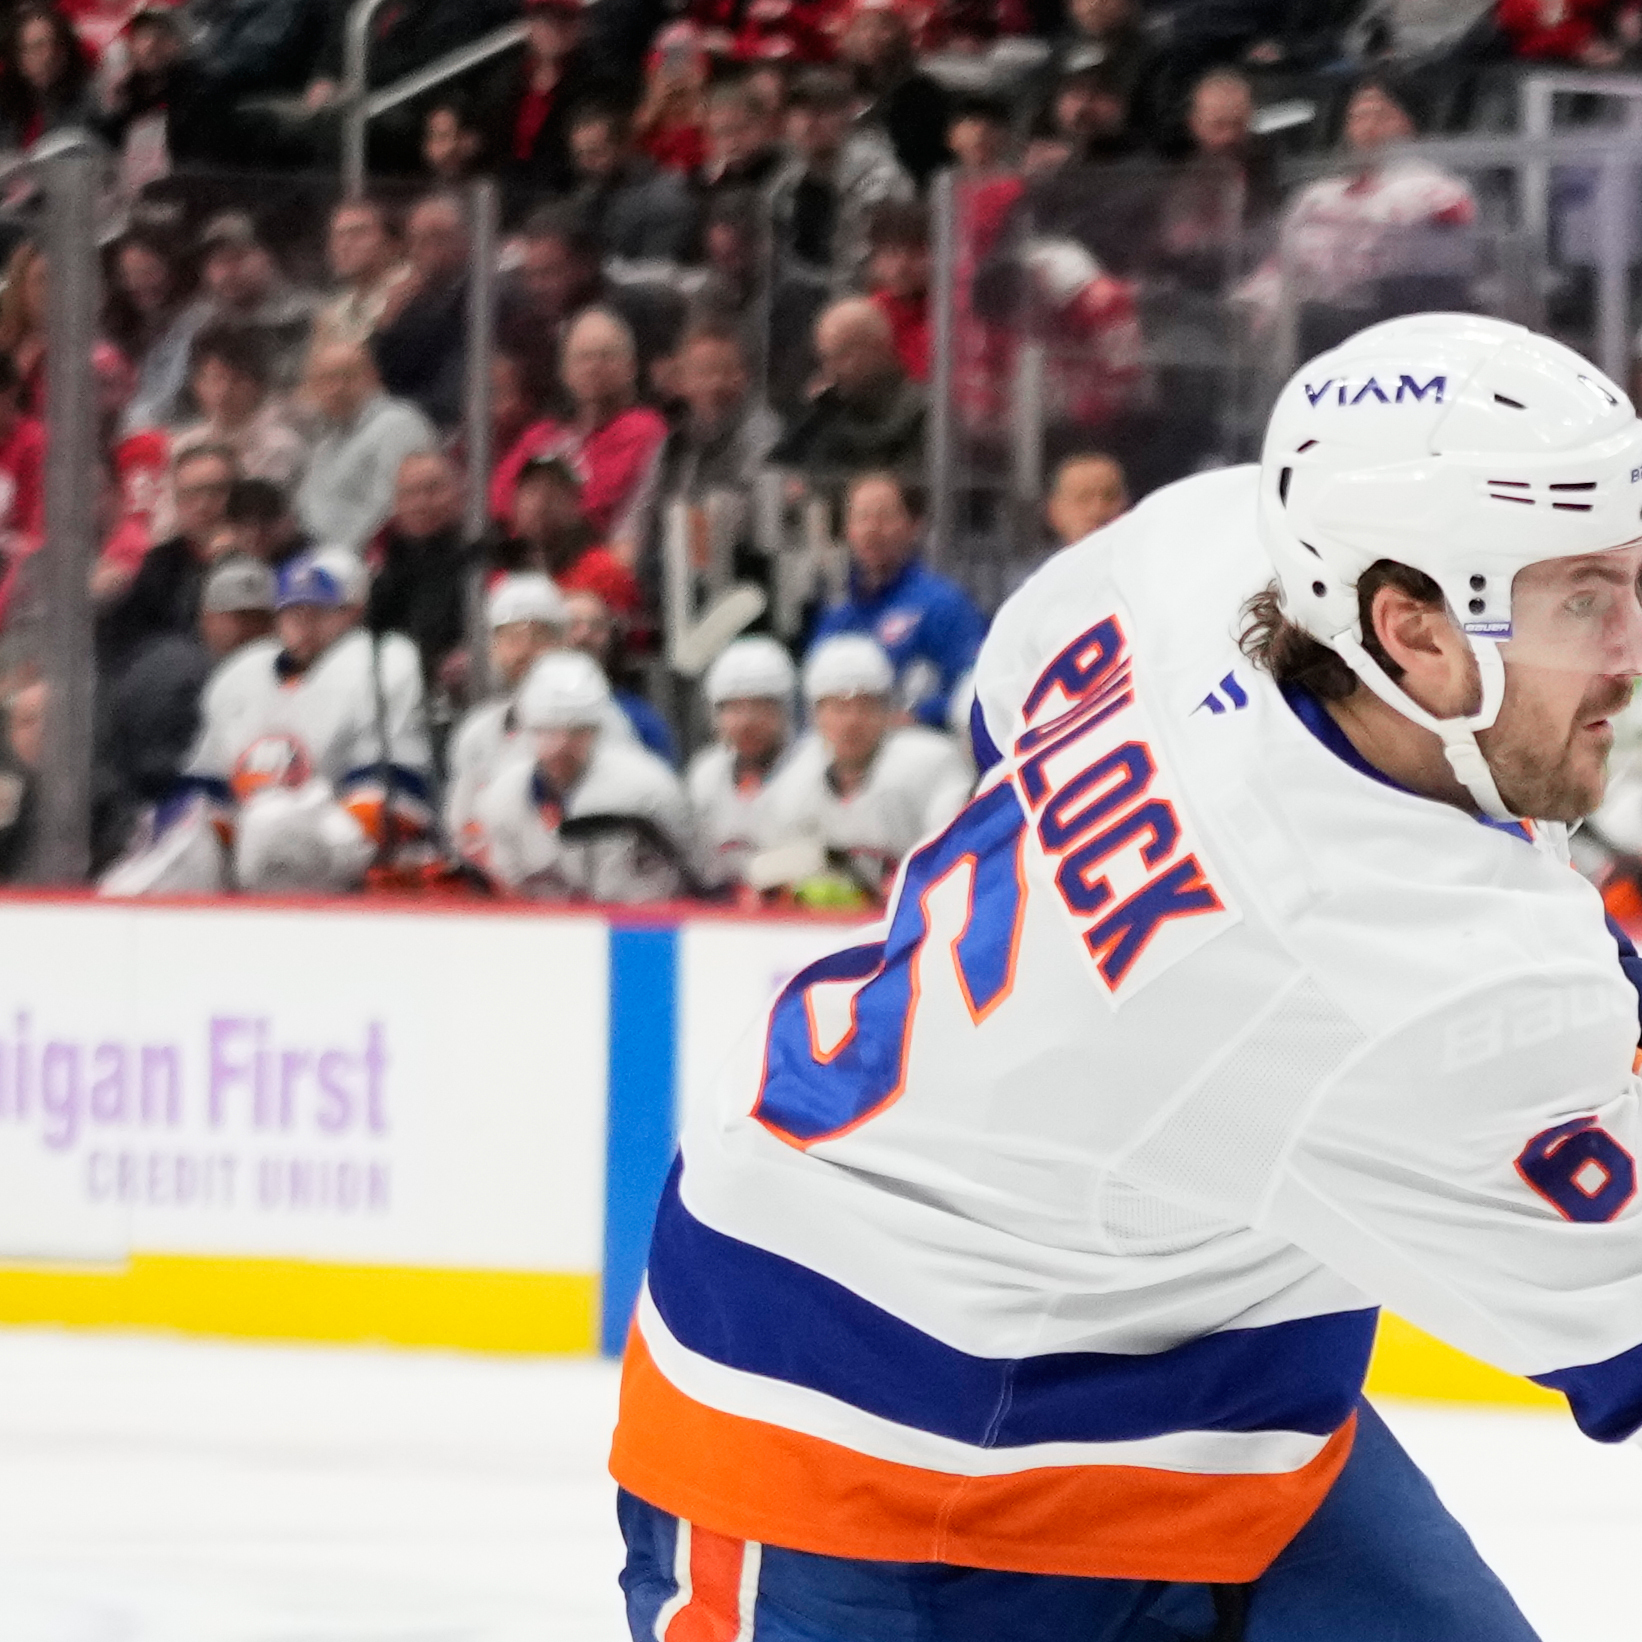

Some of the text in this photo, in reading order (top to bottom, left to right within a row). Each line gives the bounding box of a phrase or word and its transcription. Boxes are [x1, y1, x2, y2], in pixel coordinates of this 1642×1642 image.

[1303, 375, 1448, 408] VIAM
[206, 1013, 393, 1137] First
[86, 1149, 394, 1214] CREDIT UNION
[1513, 1115, 1638, 1223] 6
